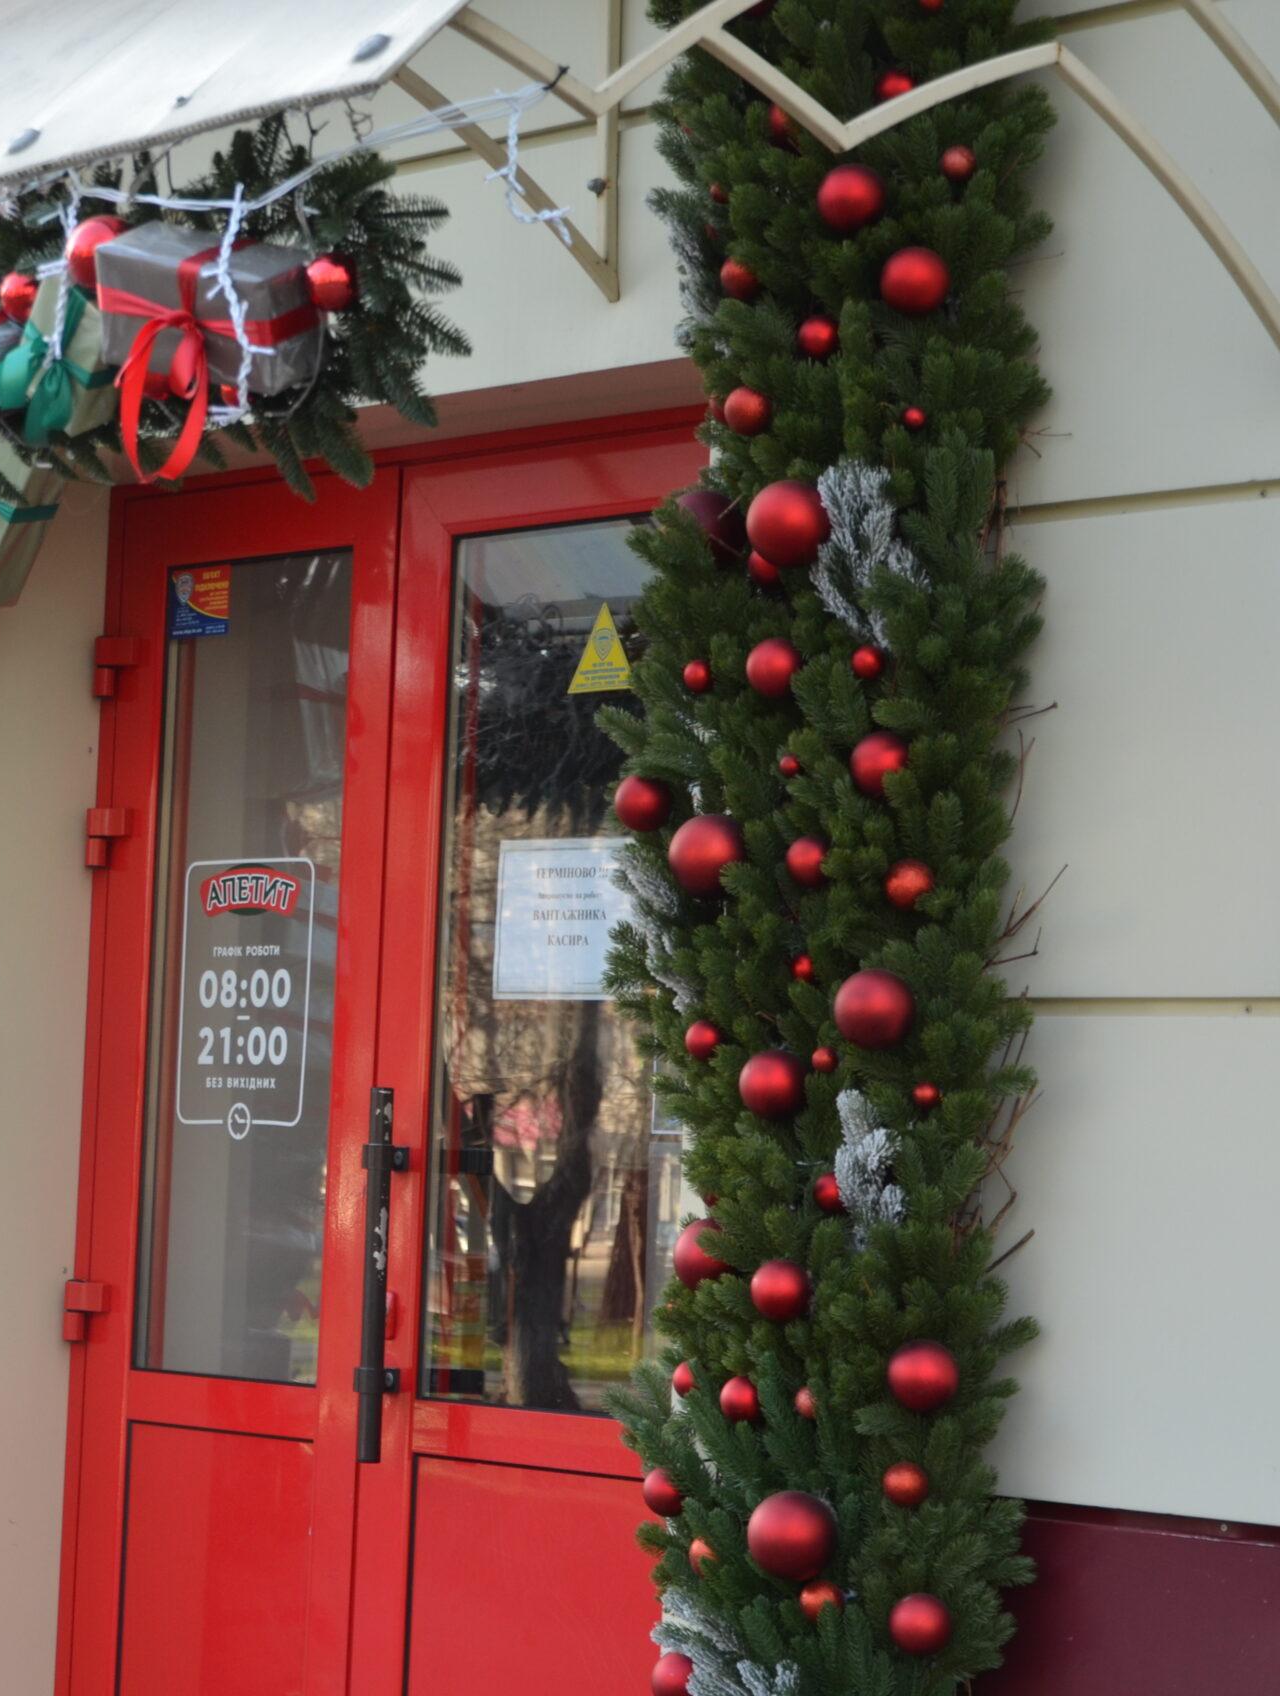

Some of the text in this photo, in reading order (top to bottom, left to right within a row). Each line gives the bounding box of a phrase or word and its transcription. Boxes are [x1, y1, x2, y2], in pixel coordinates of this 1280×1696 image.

[207, 875, 295, 910] АПЕТИТ
[533, 909, 607, 920] ВАНТАЖНИКА
[547, 935, 589, 946] КАСИРА
[213, 945, 280, 957] ГРАФІК РОБОТИ
[199, 969, 291, 1008] 08:00
[197, 1026, 288, 1065] 21:00
[206, 1077, 276, 1090] БЕЗ ВИХІДНИХ
